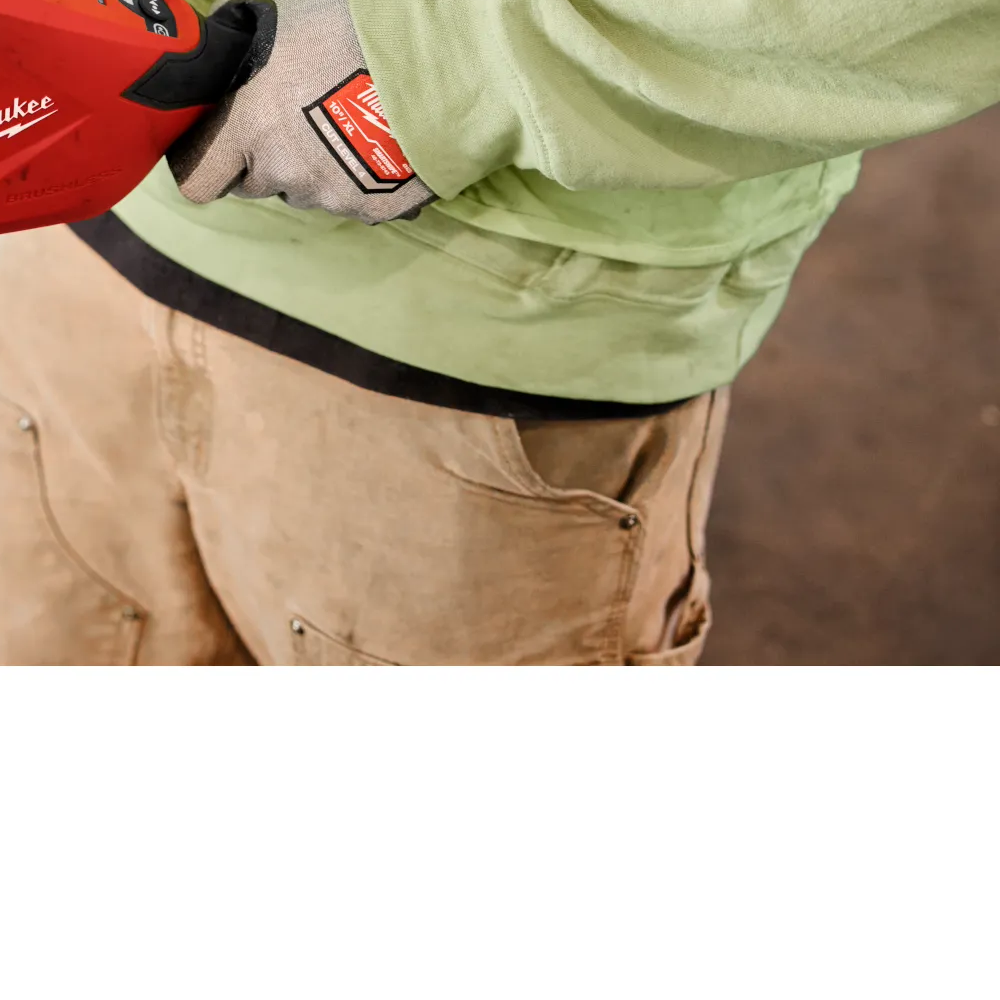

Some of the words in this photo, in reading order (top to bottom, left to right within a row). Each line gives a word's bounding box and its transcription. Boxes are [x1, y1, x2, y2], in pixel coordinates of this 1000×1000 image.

[343, 121, 357, 137] XL
[321, 123, 339, 143] CUT
[336, 143, 360, 171] LEVEL
[358, 171, 367, 179] 4
